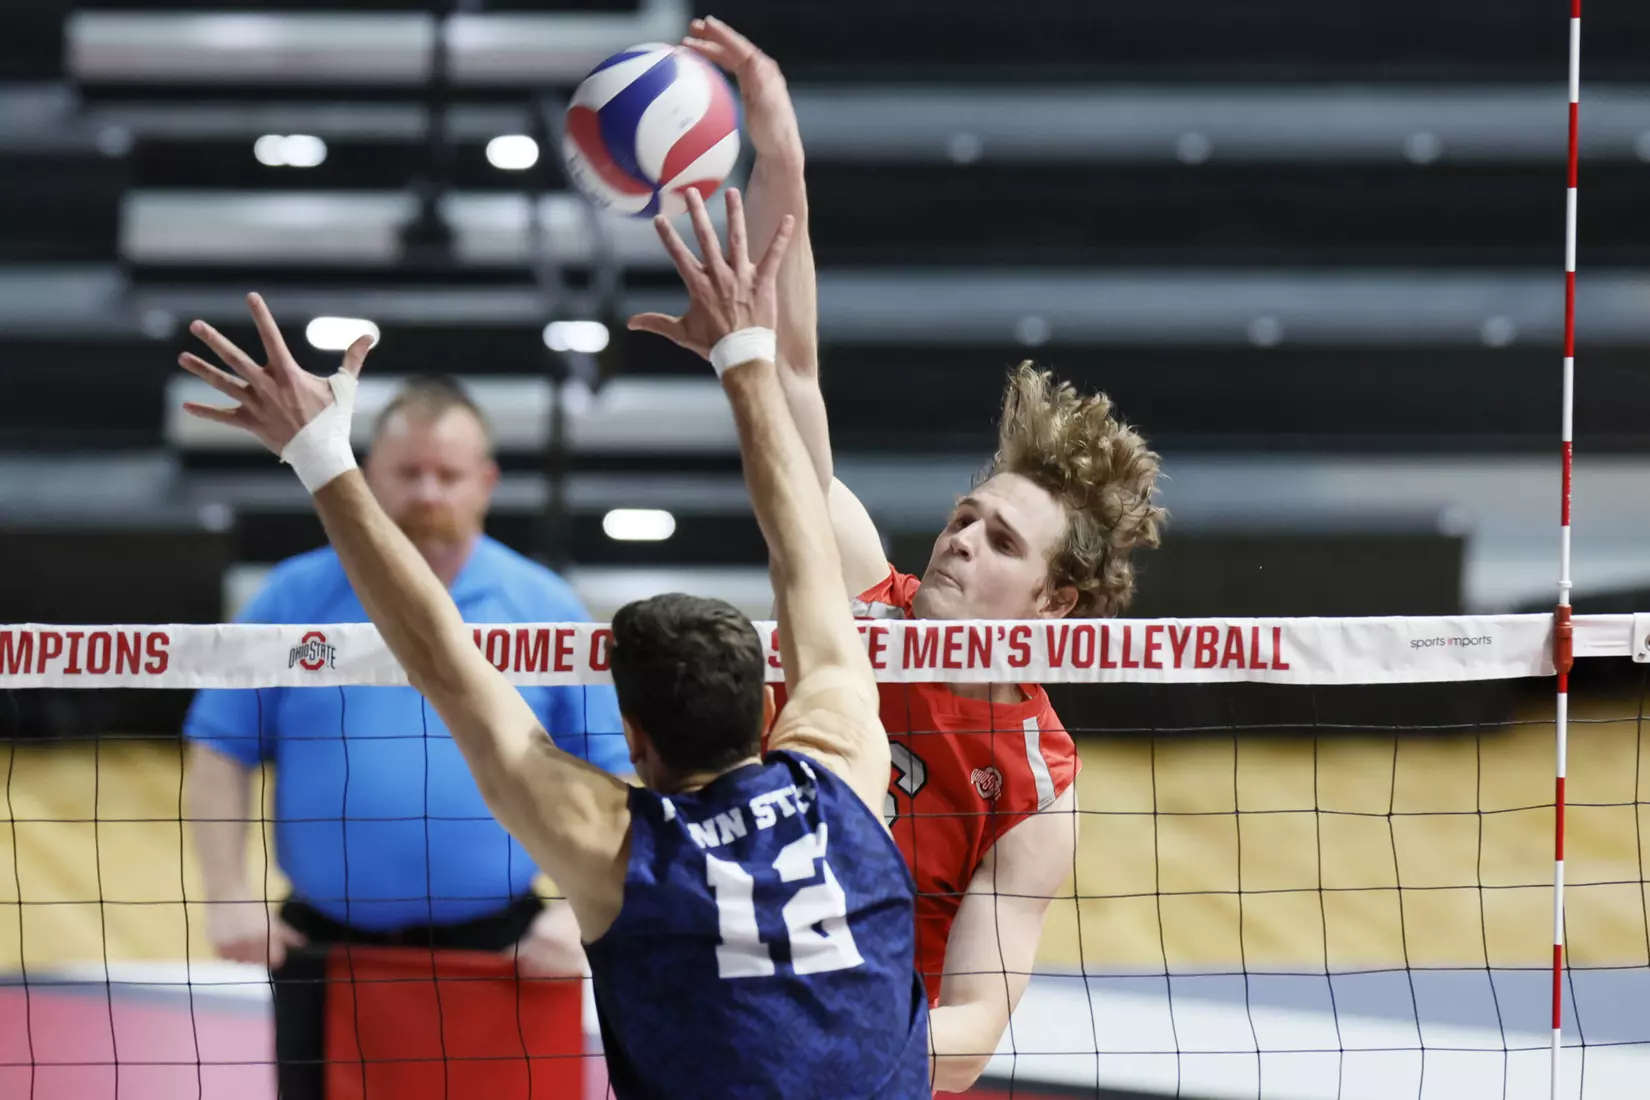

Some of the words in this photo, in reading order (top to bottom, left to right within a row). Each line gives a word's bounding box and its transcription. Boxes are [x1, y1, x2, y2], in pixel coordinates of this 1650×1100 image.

[0, 631, 170, 675] MPIONS
[589, 628, 614, 672] O
[903, 625, 1031, 668] MEN'S
[1046, 624, 1290, 671] VOLLEYBALL
[1410, 637, 1445, 650] sports
[706, 822, 865, 979] 12
